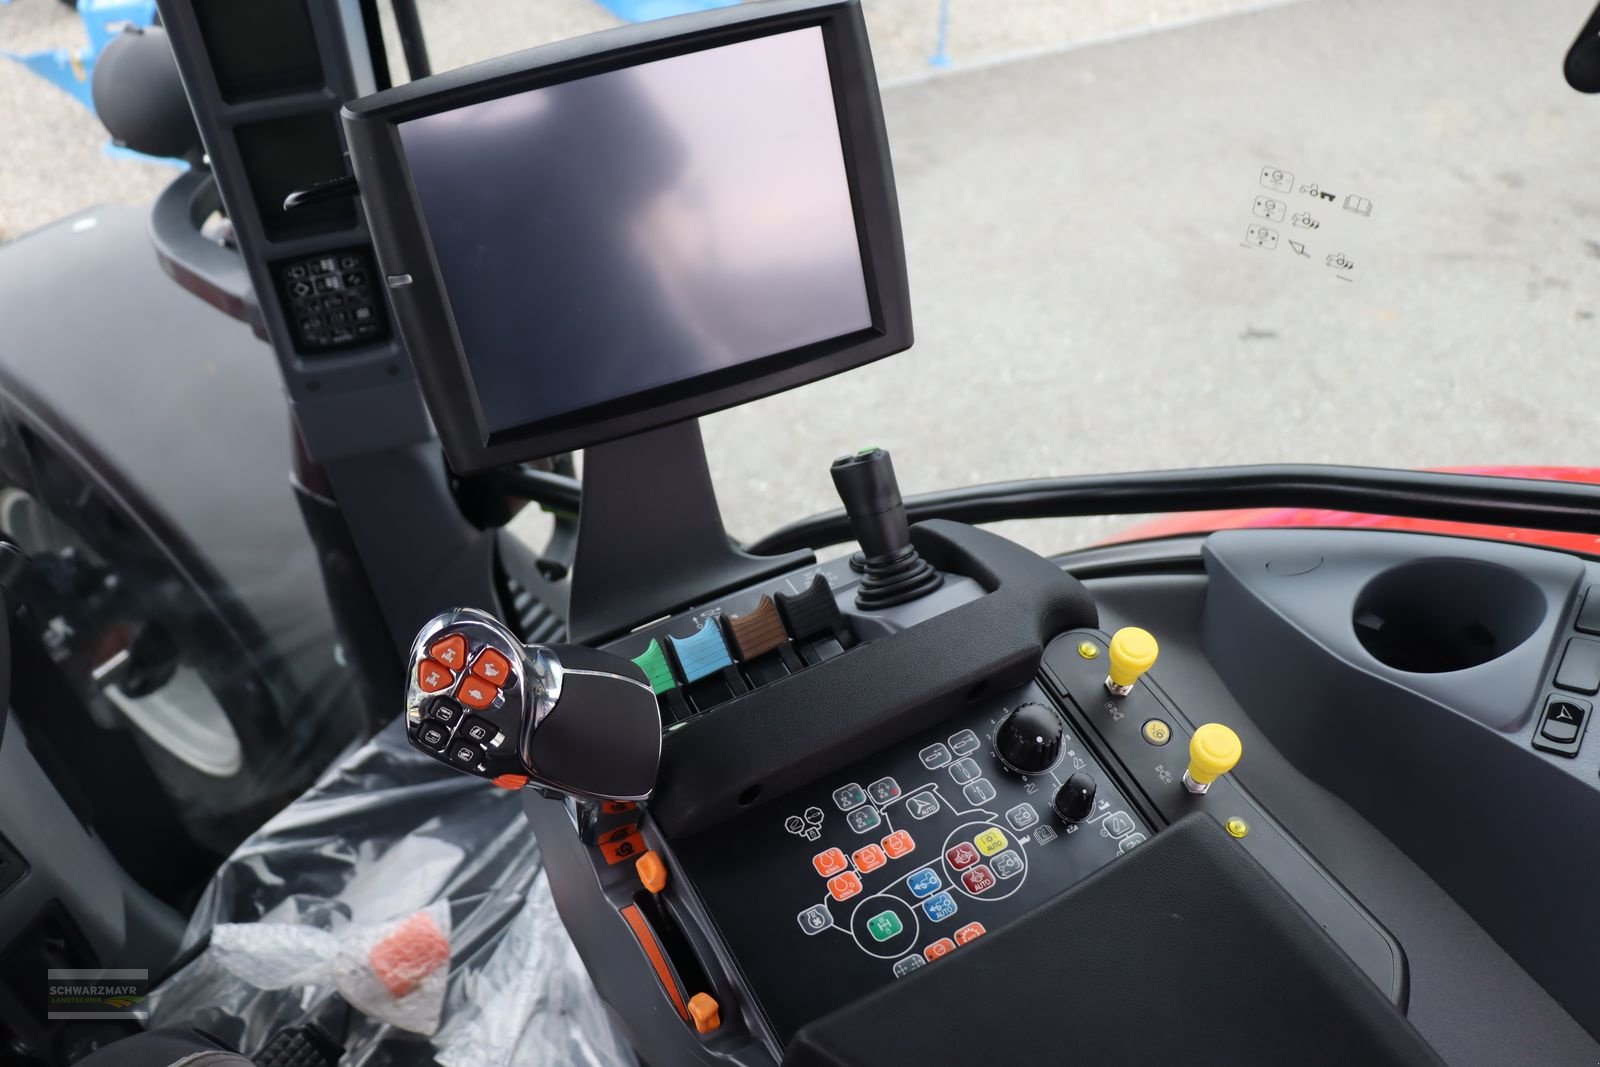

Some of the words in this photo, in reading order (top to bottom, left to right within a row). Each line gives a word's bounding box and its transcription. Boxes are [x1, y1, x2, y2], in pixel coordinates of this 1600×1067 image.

[921, 805, 937, 816] AUTO
[986, 840, 1003, 852] AUTO
[974, 878, 991, 891] AUTO
[936, 907, 953, 919] AUTO
